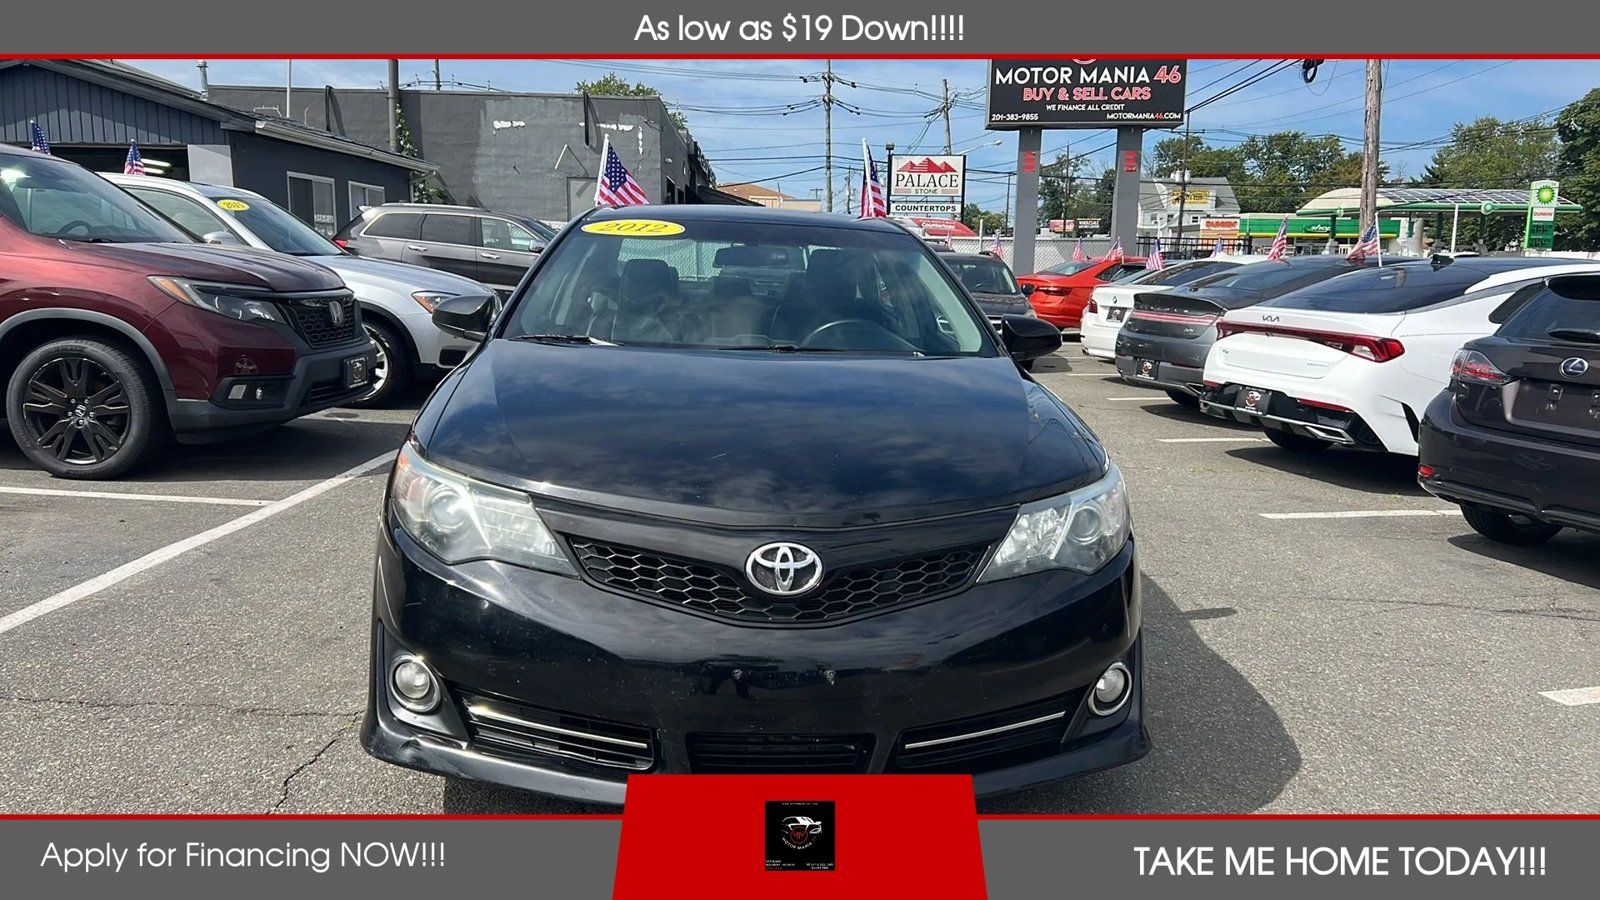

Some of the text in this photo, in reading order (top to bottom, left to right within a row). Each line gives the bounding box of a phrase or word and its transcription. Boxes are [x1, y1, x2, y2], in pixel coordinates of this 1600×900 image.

[995, 65, 1182, 85] MOTOR MANIA 46
[1023, 86, 1152, 101] BUY & SELL CARS
[1101, 103, 1126, 111] CREDIT
[991, 113, 1039, 121] 201-383-9855
[895, 173, 959, 188] PALACE
[598, 222, 668, 233] 2012
